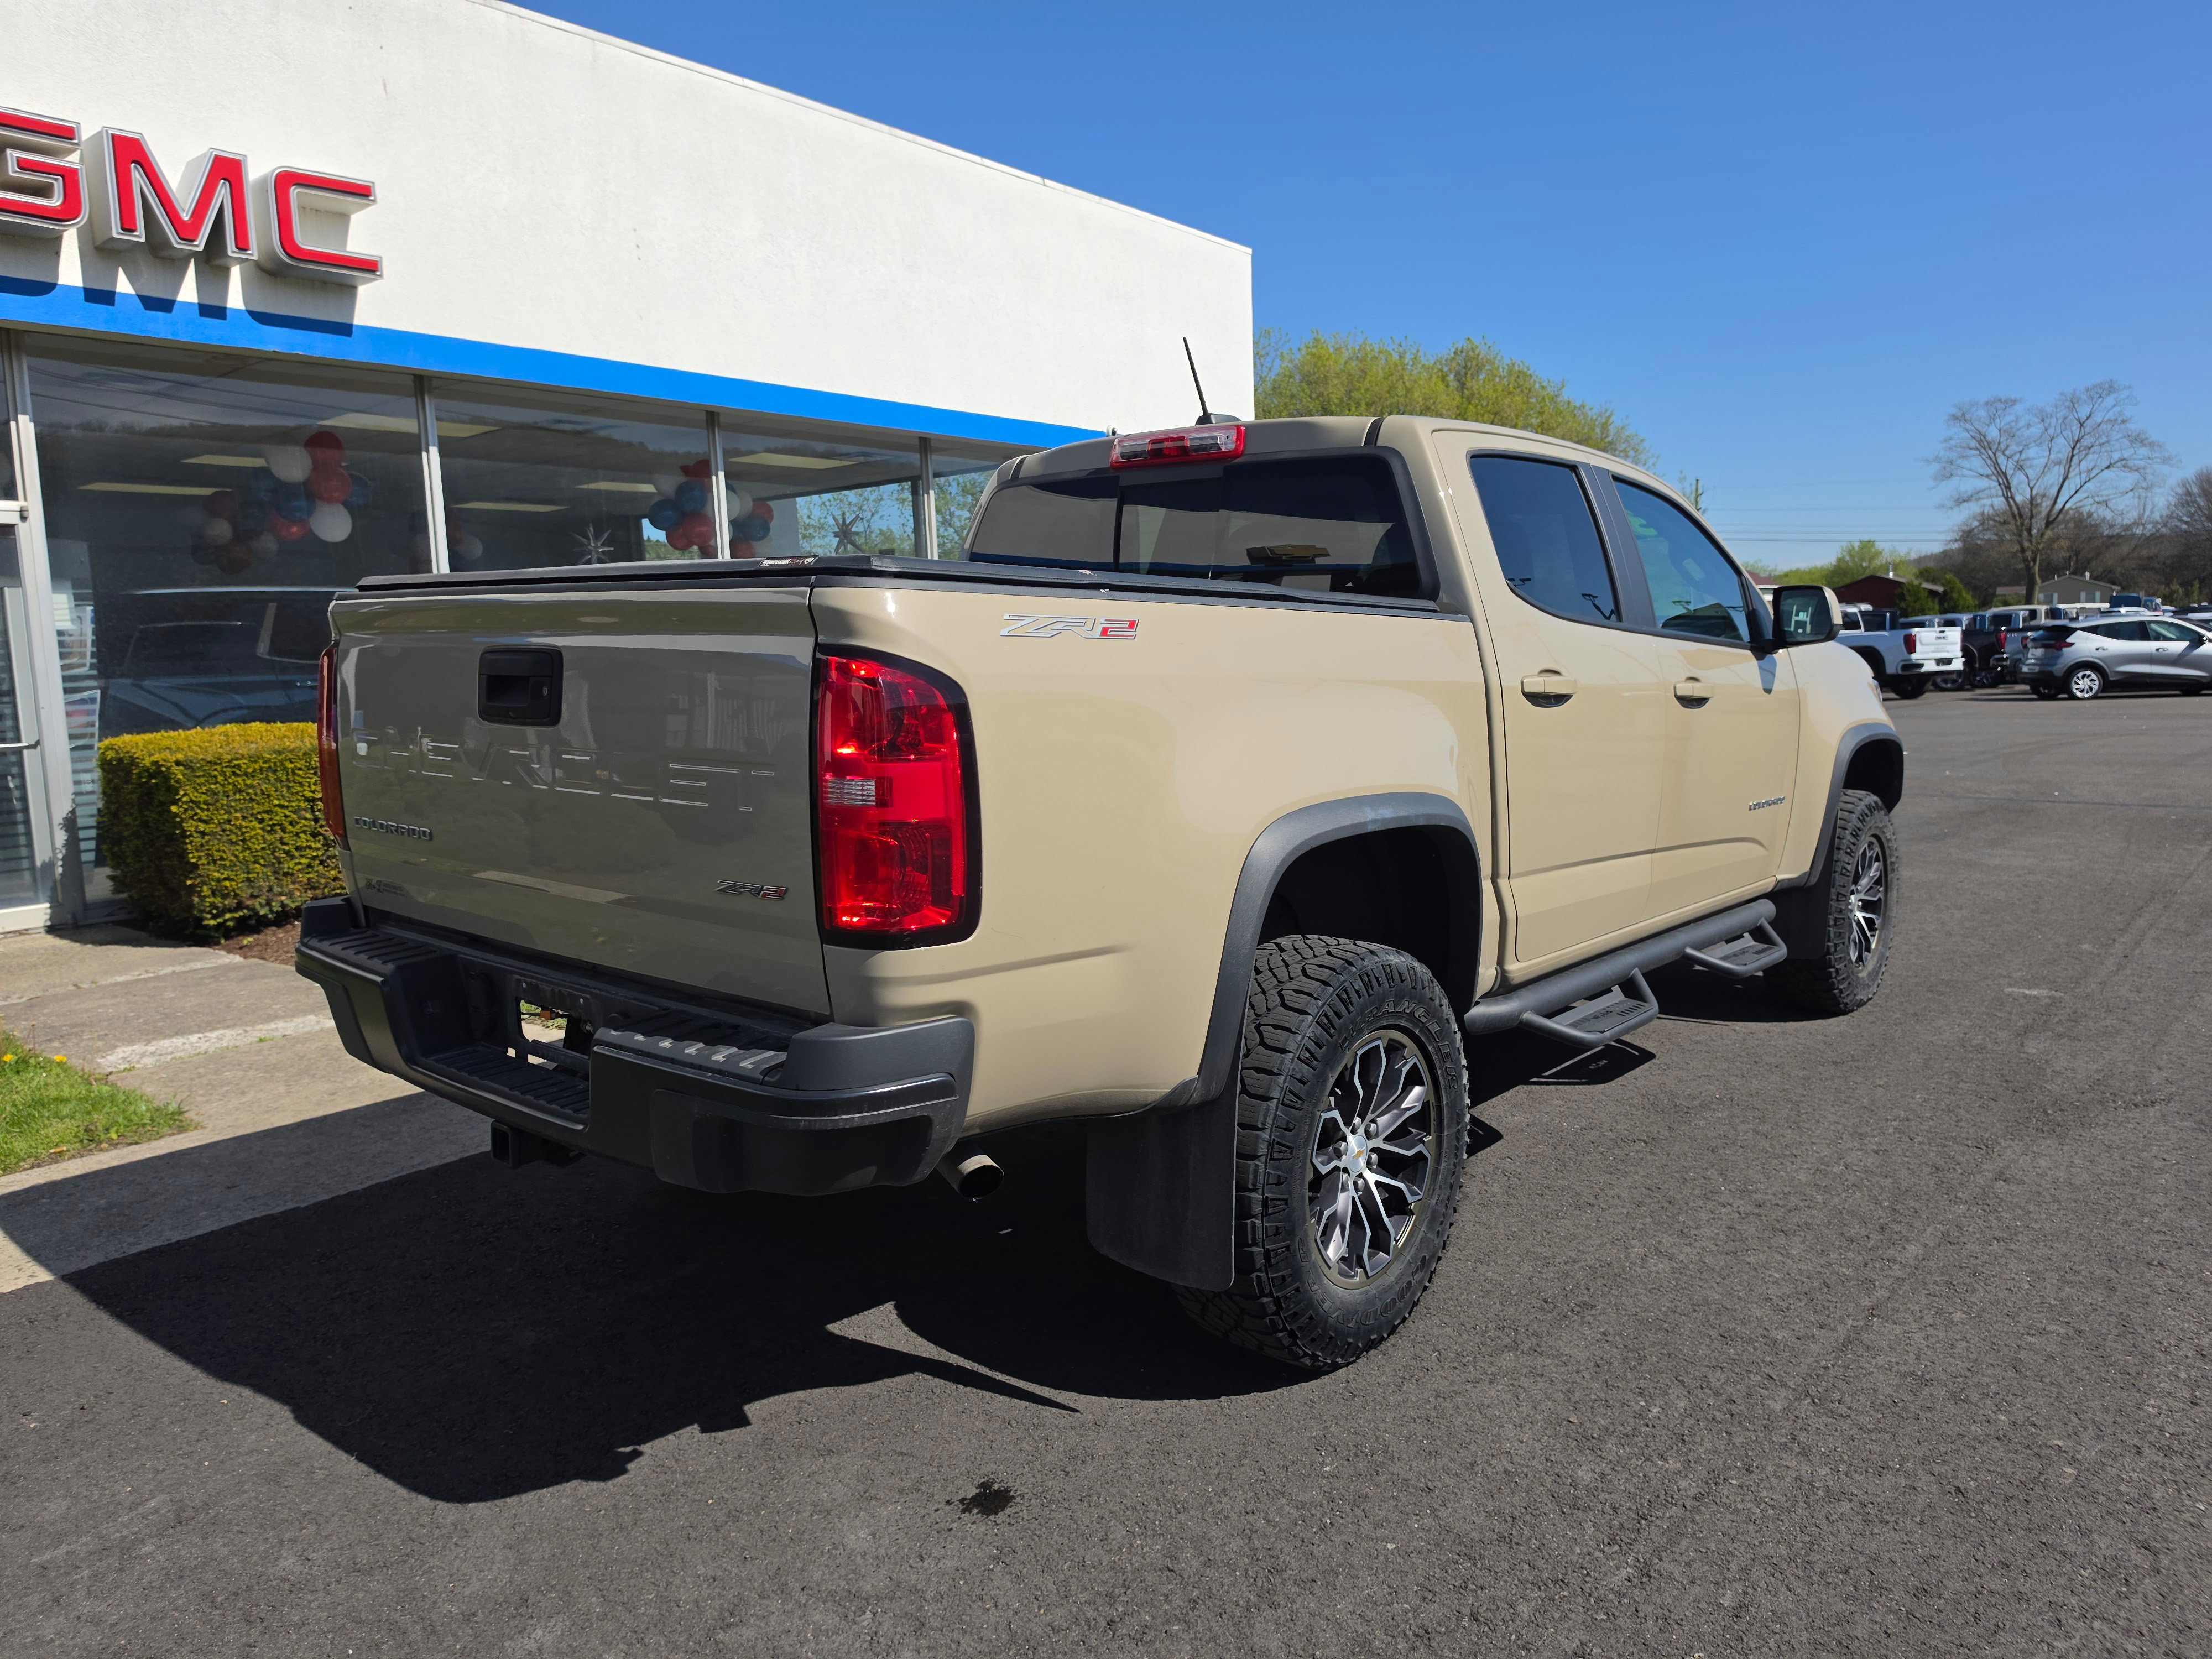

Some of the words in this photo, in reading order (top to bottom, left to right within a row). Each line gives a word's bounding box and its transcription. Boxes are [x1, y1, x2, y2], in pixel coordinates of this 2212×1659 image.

[0, 106, 384, 285] GMC
[999, 613, 1140, 640] ZR2
[353, 816, 434, 841] COLORADO
[714, 879, 789, 901] ZR2
